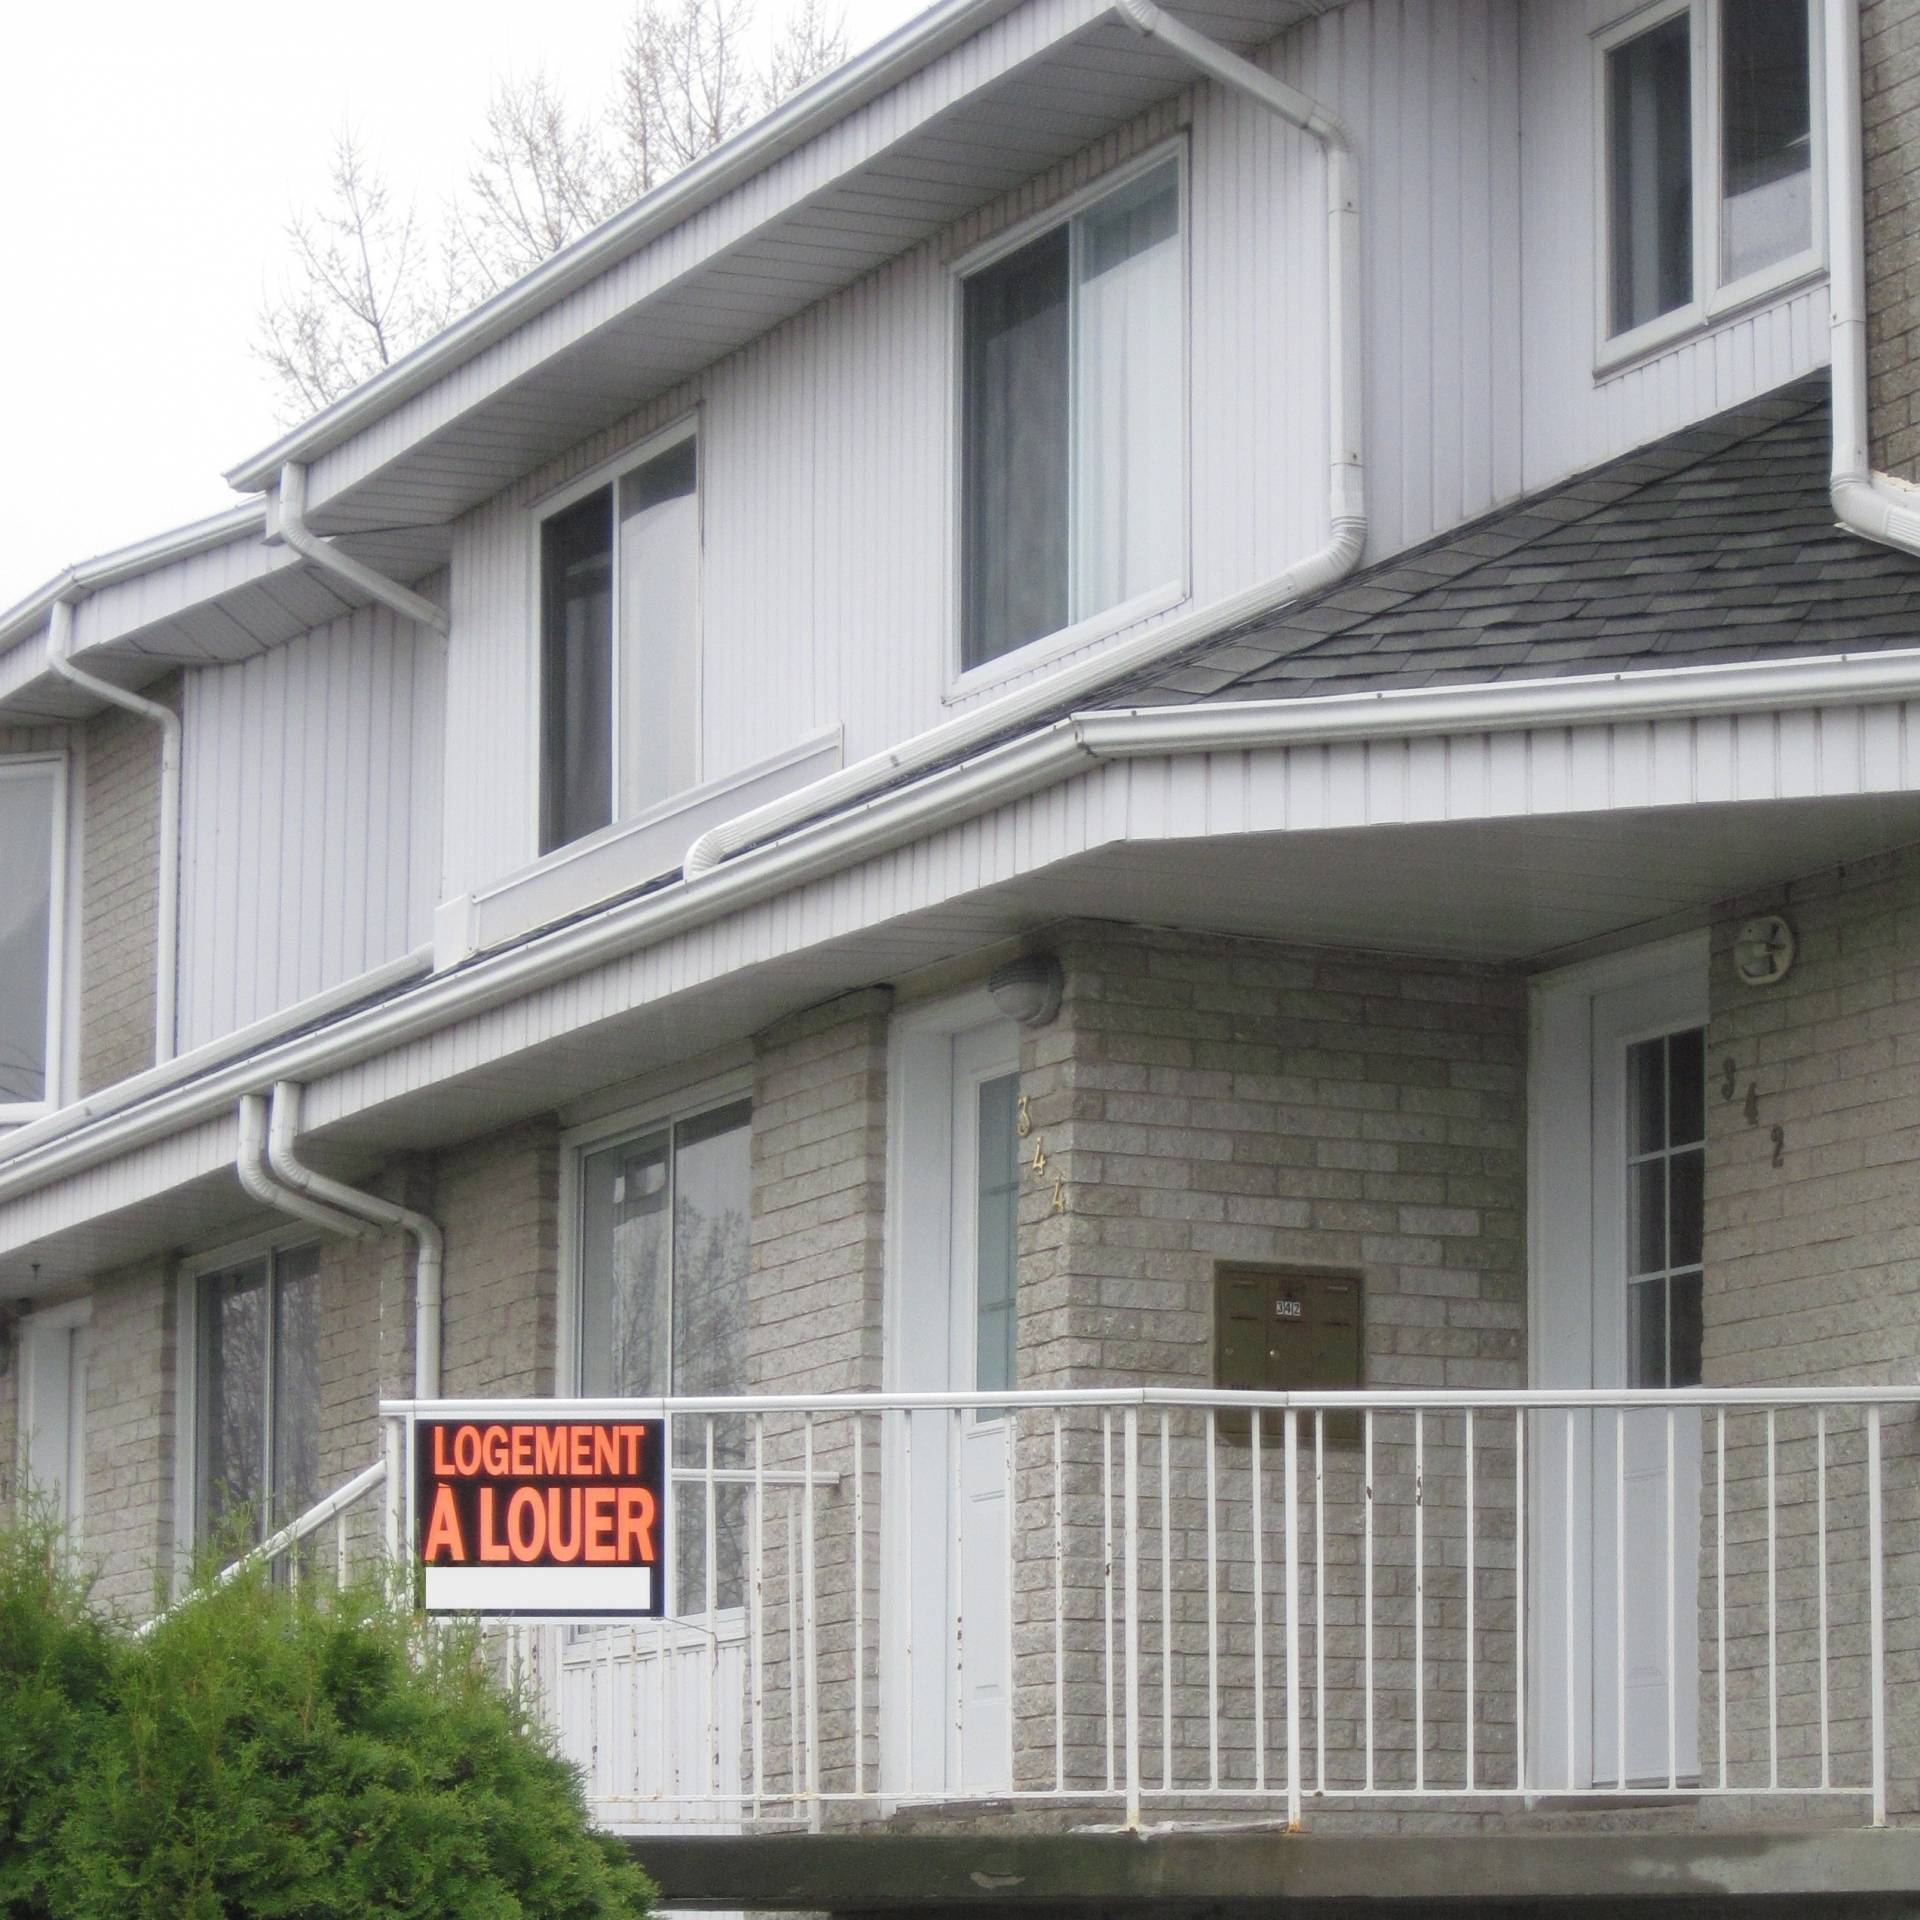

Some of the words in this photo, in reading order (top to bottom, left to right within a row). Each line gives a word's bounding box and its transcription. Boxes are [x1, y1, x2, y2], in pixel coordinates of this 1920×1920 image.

[1276, 1300, 1301, 1316] 342
[433, 1425, 645, 1475] LOGEMENT
[425, 1482, 465, 1561] À
[480, 1486, 655, 1562] LOUER
